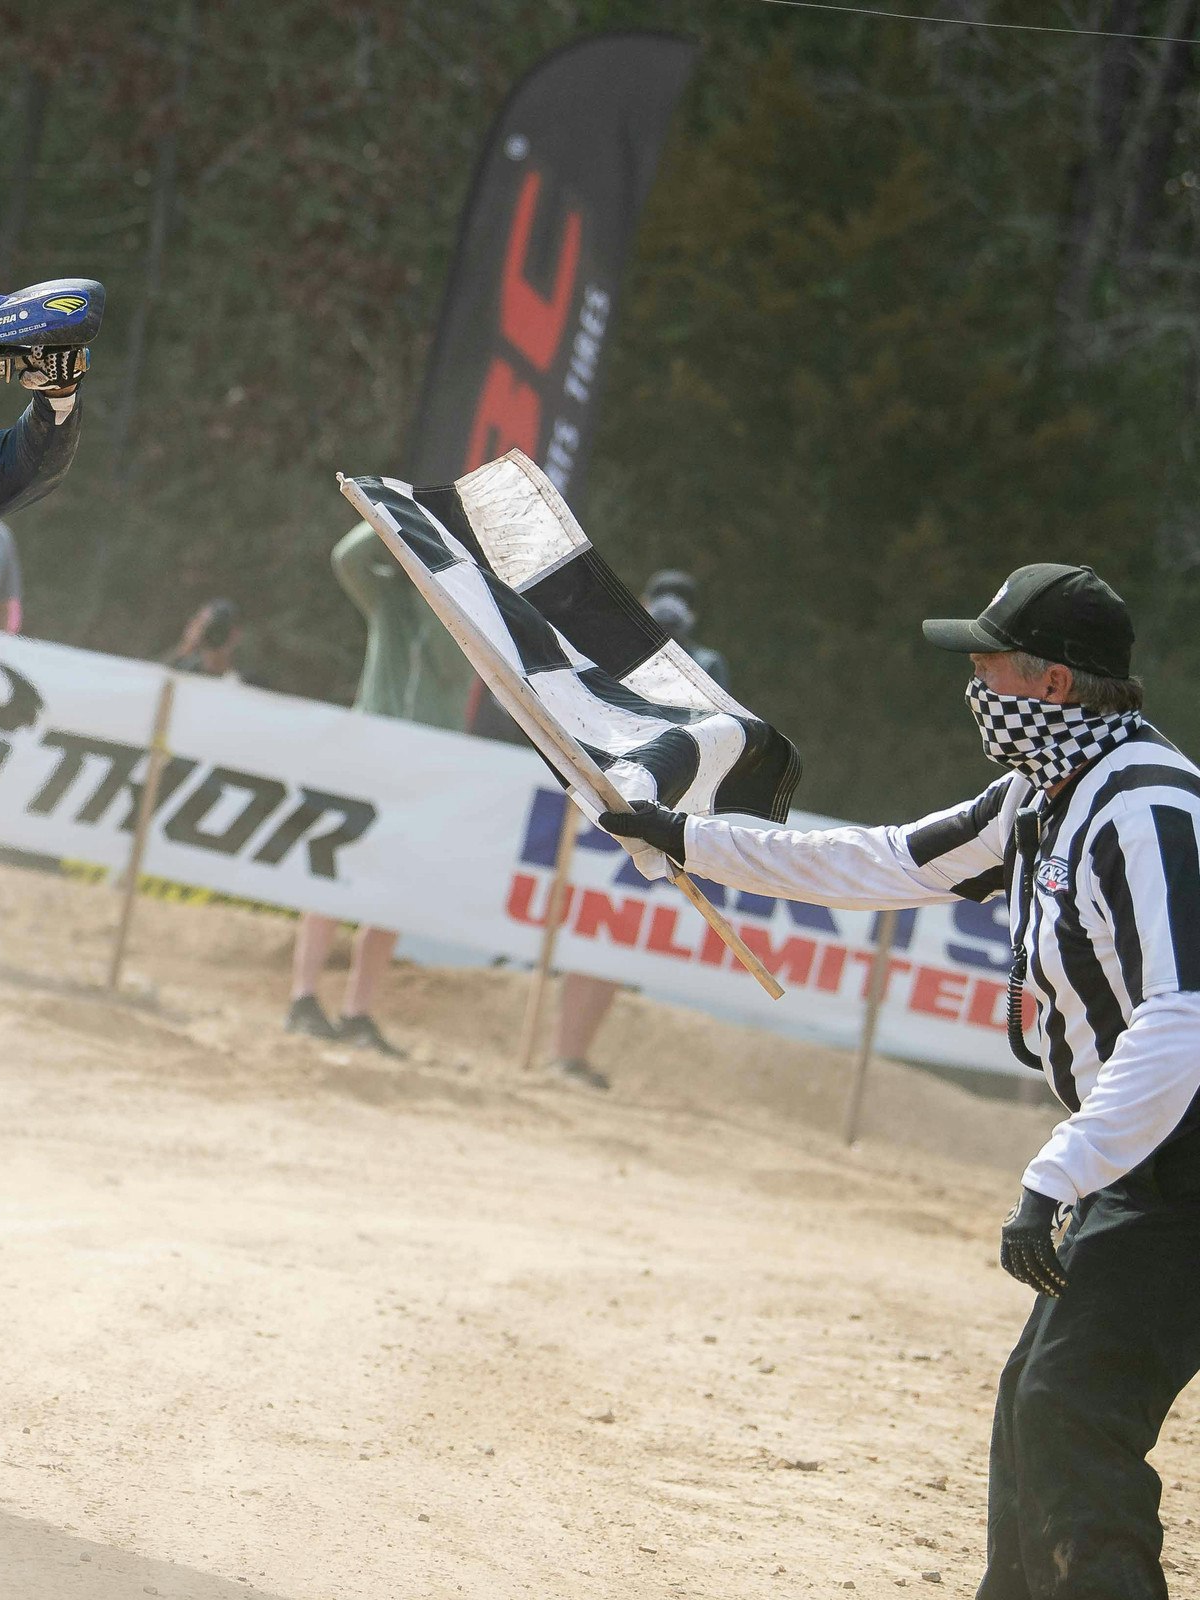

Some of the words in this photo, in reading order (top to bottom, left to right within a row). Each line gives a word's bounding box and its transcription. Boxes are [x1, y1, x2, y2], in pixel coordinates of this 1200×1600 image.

[463, 171, 583, 474] BC
[26, 728, 377, 881] THOR
[504, 870, 1038, 1036] UNLIMITED
